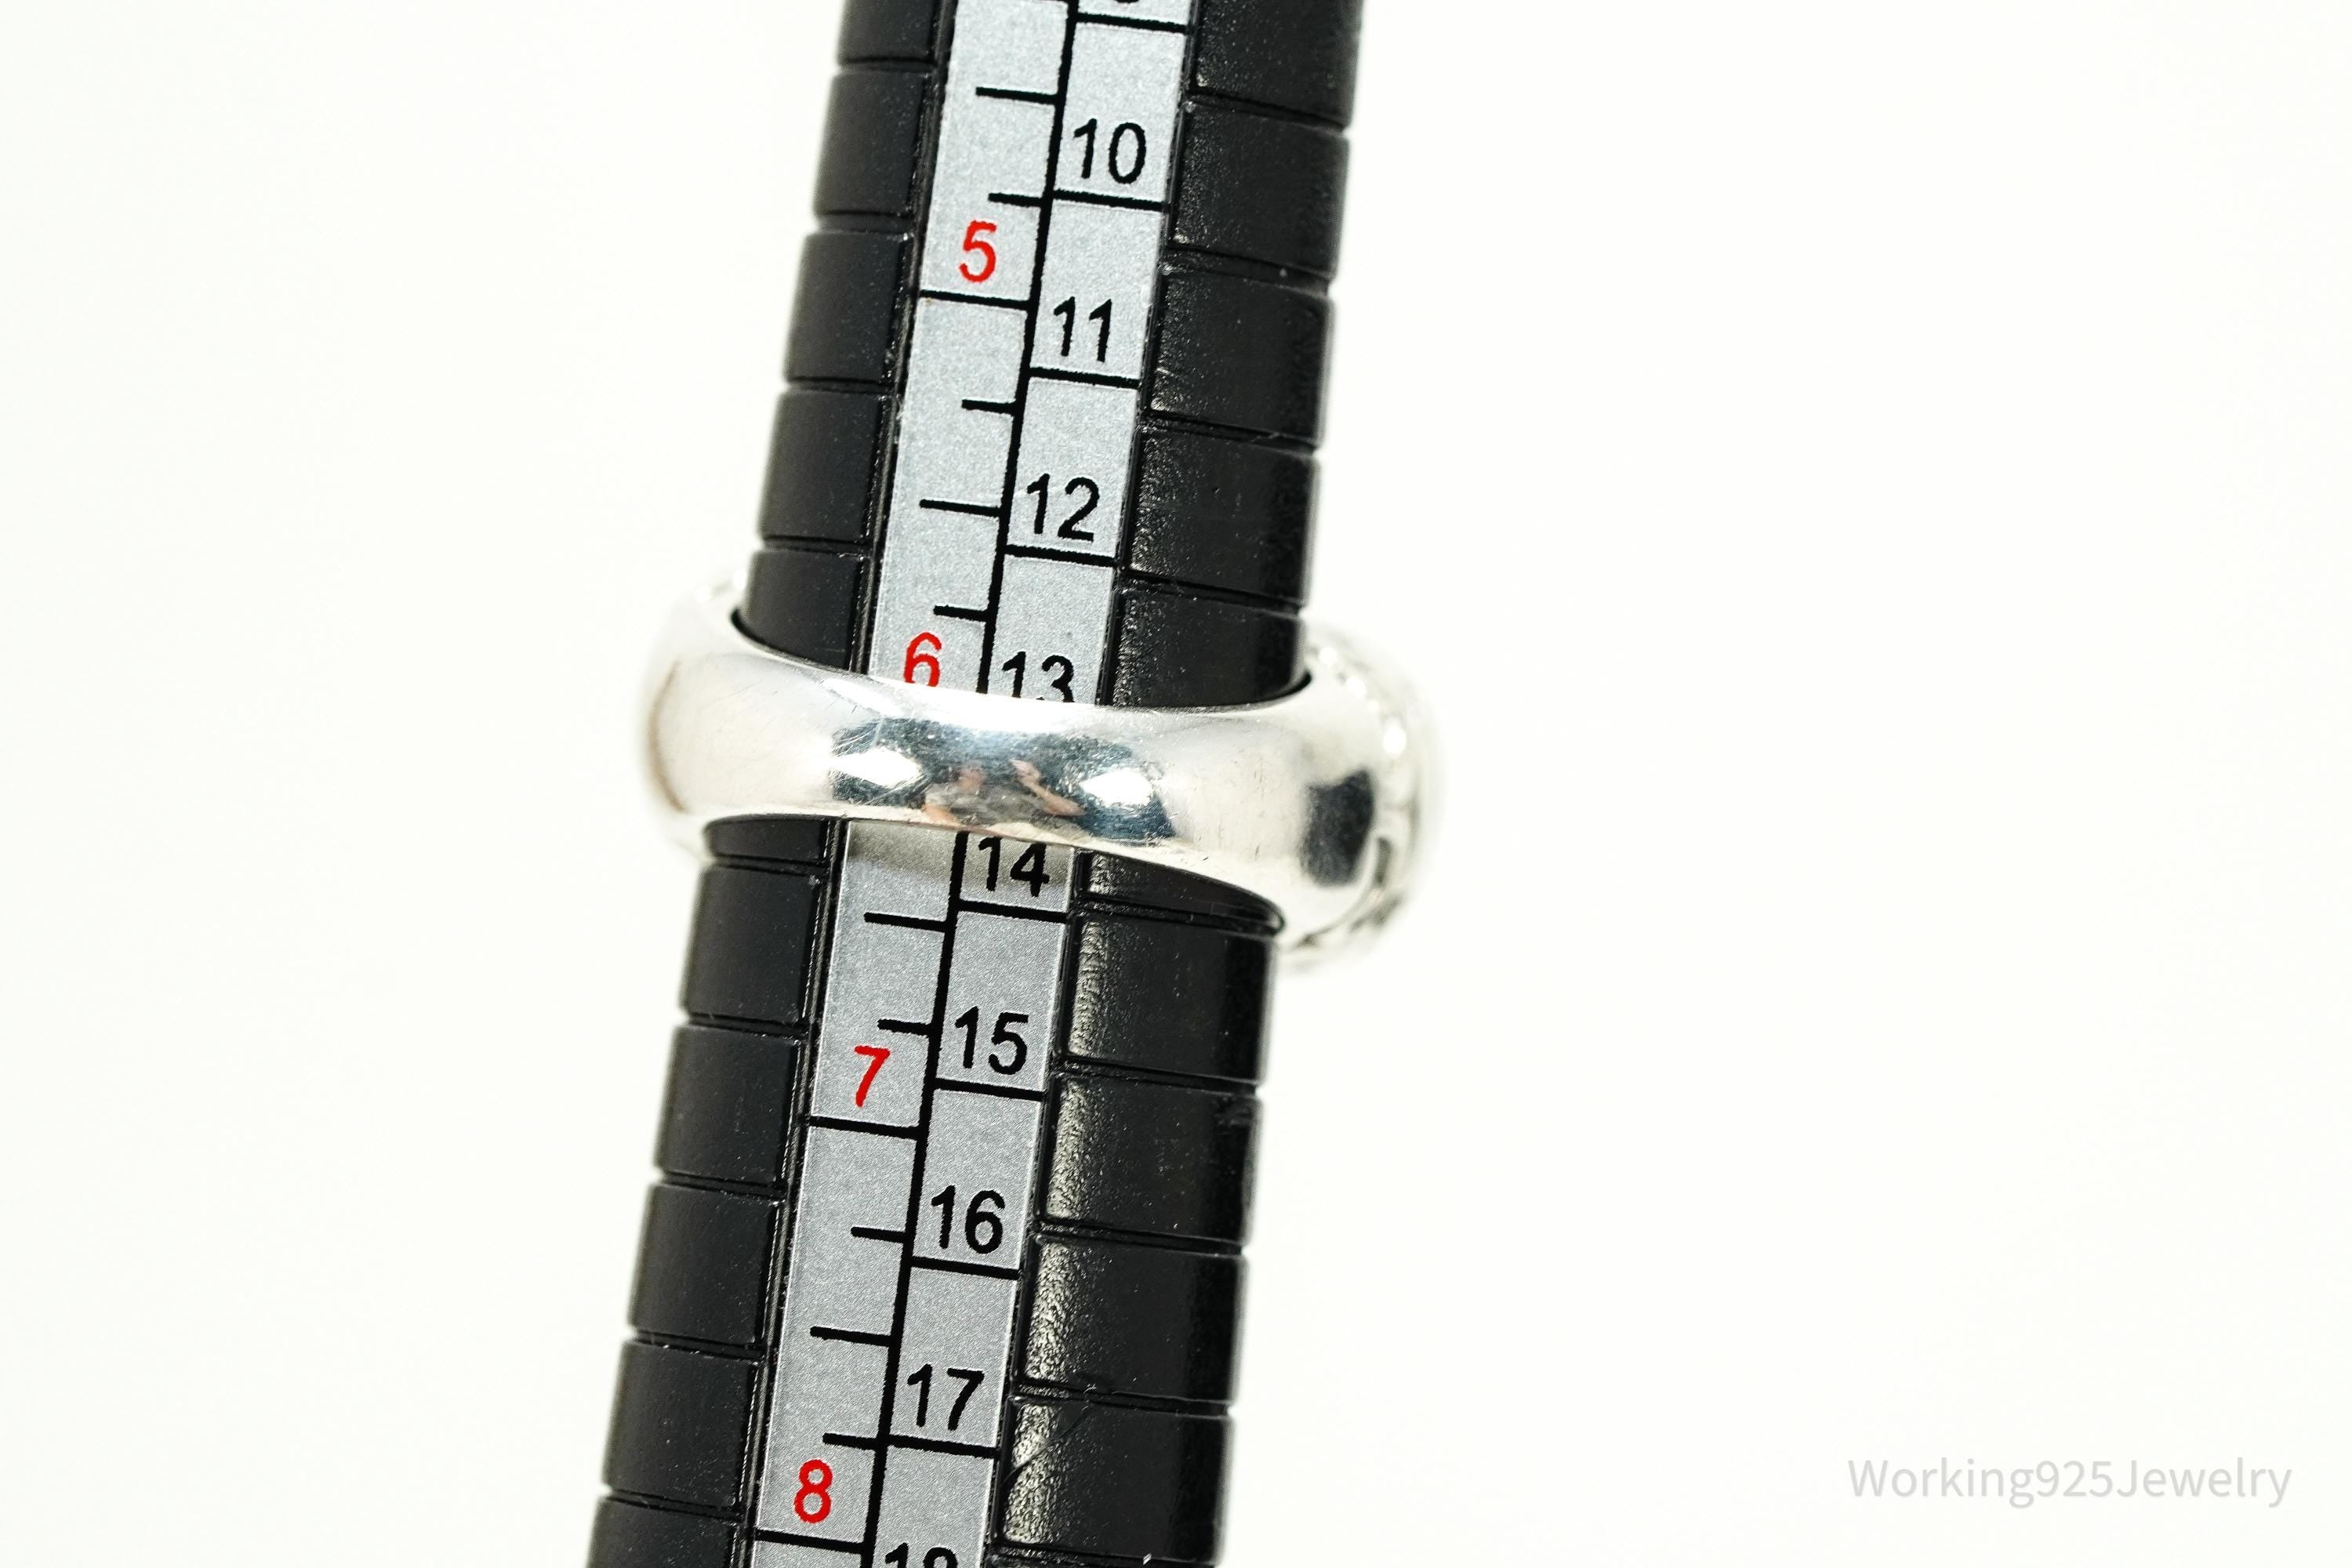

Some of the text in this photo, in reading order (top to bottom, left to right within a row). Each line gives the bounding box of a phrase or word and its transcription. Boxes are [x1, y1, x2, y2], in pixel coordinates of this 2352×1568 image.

[1073, 118, 1147, 185] 10
[959, 220, 997, 282] 5
[1053, 297, 1112, 362] 11
[1026, 474, 1100, 542] 12
[903, 632, 942, 688] 6
[1001, 651, 1076, 703] 13
[978, 836, 1051, 898] 14
[954, 1006, 1029, 1075] 15
[854, 1045, 891, 1107] 7
[931, 1185, 1006, 1254] 16
[906, 1363, 985, 1431] 17
[793, 1459, 833, 1524] 8
